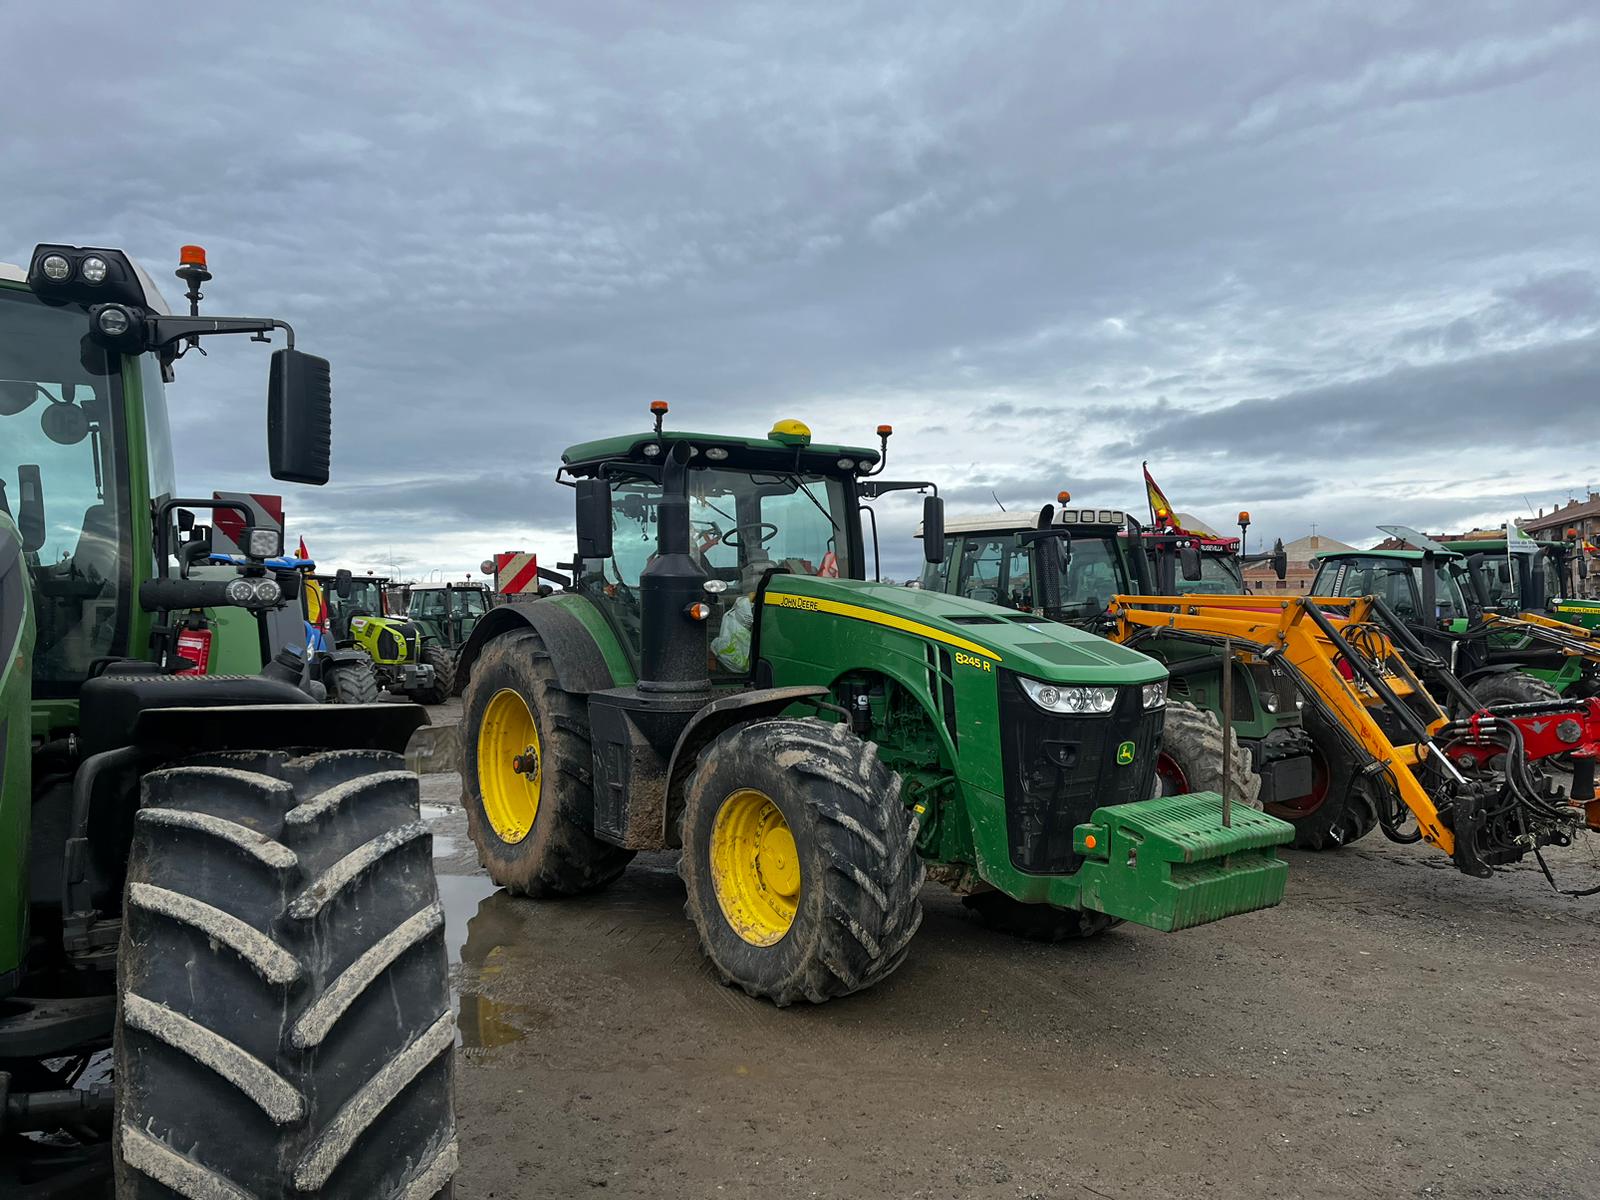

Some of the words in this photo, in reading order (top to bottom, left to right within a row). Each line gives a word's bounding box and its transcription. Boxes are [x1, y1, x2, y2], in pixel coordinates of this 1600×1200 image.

[780, 596, 798, 608] JOHN
[797, 597, 818, 611] DEERE
[955, 652, 981, 668] 8245
[983, 660, 991, 672] R
